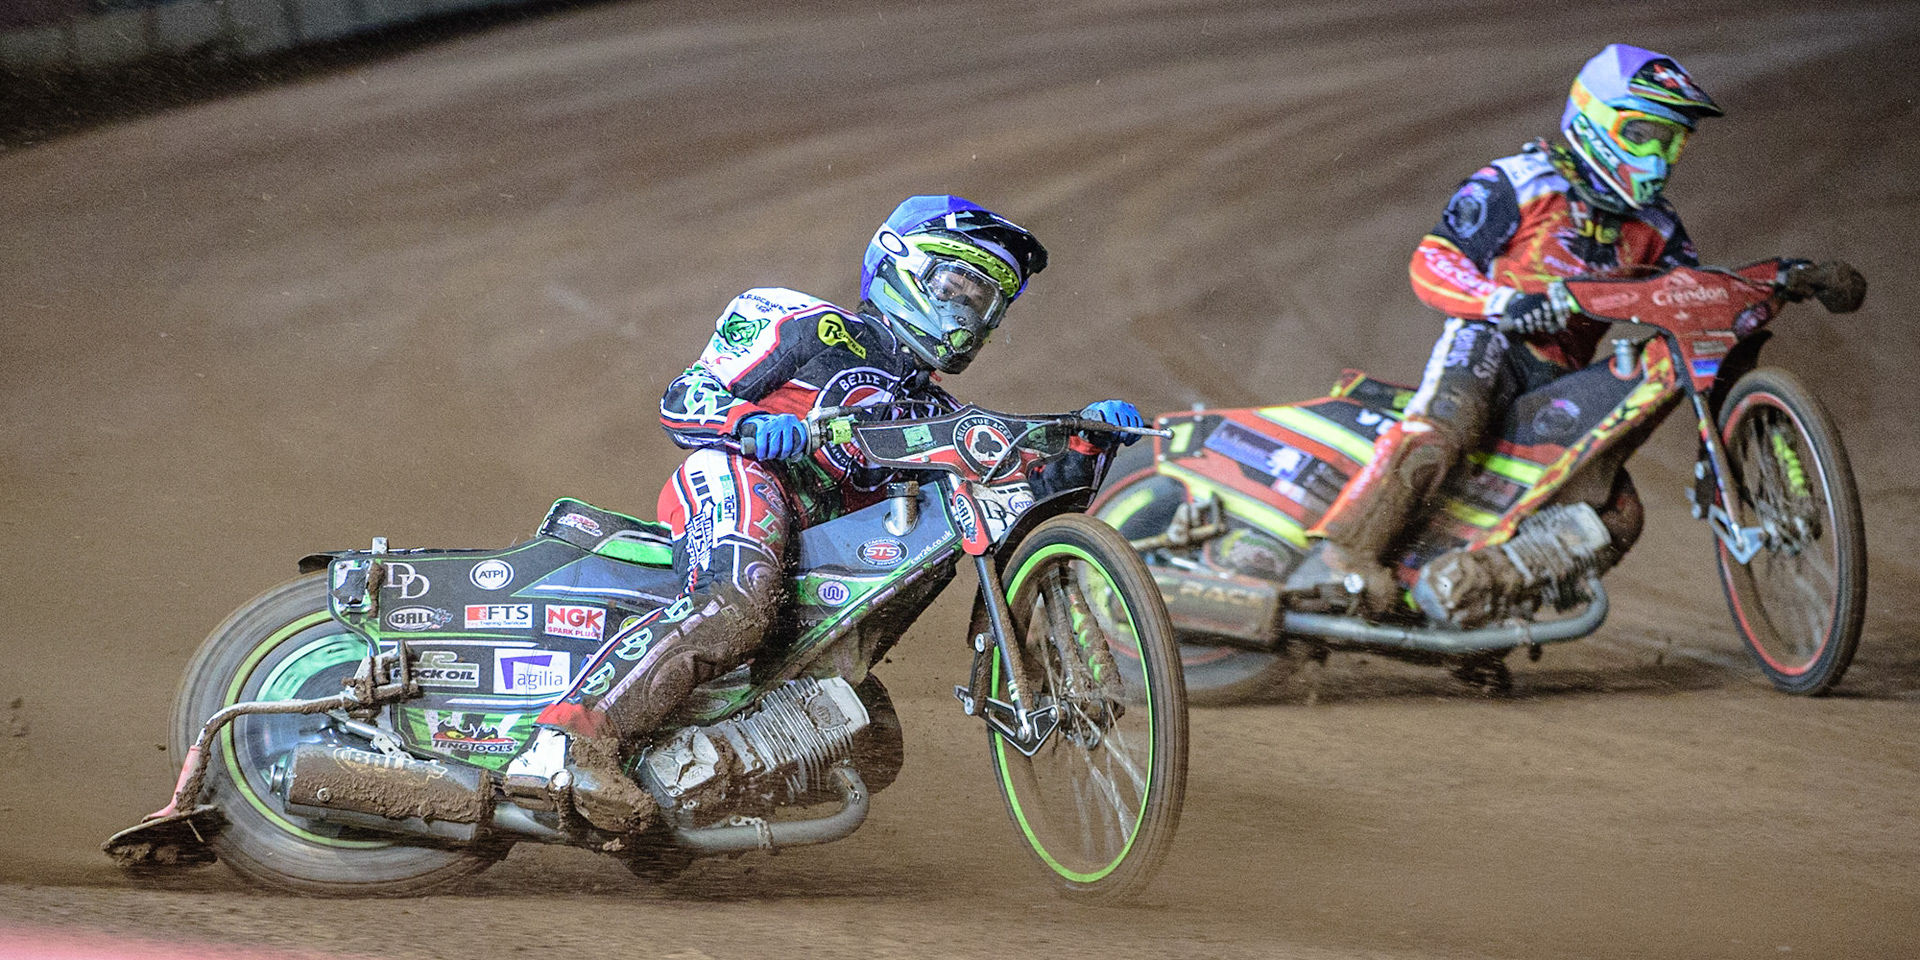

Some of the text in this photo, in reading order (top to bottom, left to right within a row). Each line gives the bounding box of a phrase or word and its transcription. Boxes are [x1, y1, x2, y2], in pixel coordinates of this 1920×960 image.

[1652, 284, 1730, 306] Crendon
[838, 372, 881, 392] BELLE
[956, 419, 972, 441] BELLE
[971, 416, 990, 426] VUE
[866, 547, 898, 557] STS
[478, 570, 504, 579] ATPI
[488, 605, 529, 620] FTS
[547, 607, 604, 631] NGK
[547, 626, 574, 636] SPARK
[445, 669, 476, 680] OIL
[516, 670, 563, 690] agilia
